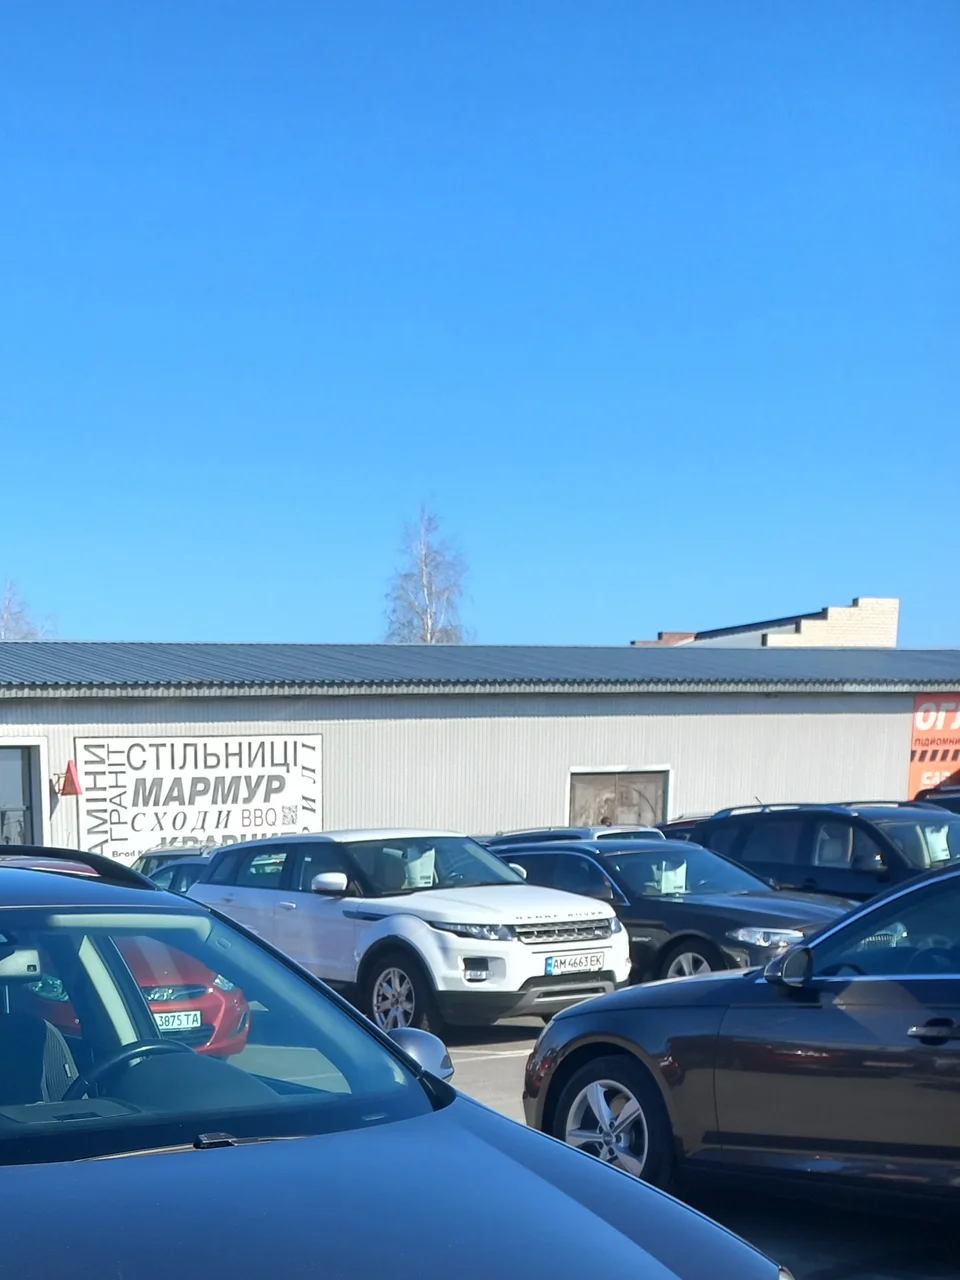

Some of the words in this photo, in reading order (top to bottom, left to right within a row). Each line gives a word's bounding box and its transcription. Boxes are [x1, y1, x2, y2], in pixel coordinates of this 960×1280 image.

[126, 740, 298, 773] СТІЛЬНИЦІ
[107, 743, 129, 841] ГРАНІТ
[131, 775, 286, 808] МАРМУР
[130, 809, 232, 834] СХОДИ
[241, 808, 277, 828] BBQ
[553, 958, 567, 970] AM
[567, 956, 589, 968] 4663
[590, 954, 602, 966] EK
[158, 1014, 182, 1027] 3875
[184, 1013, 199, 1026] TA
